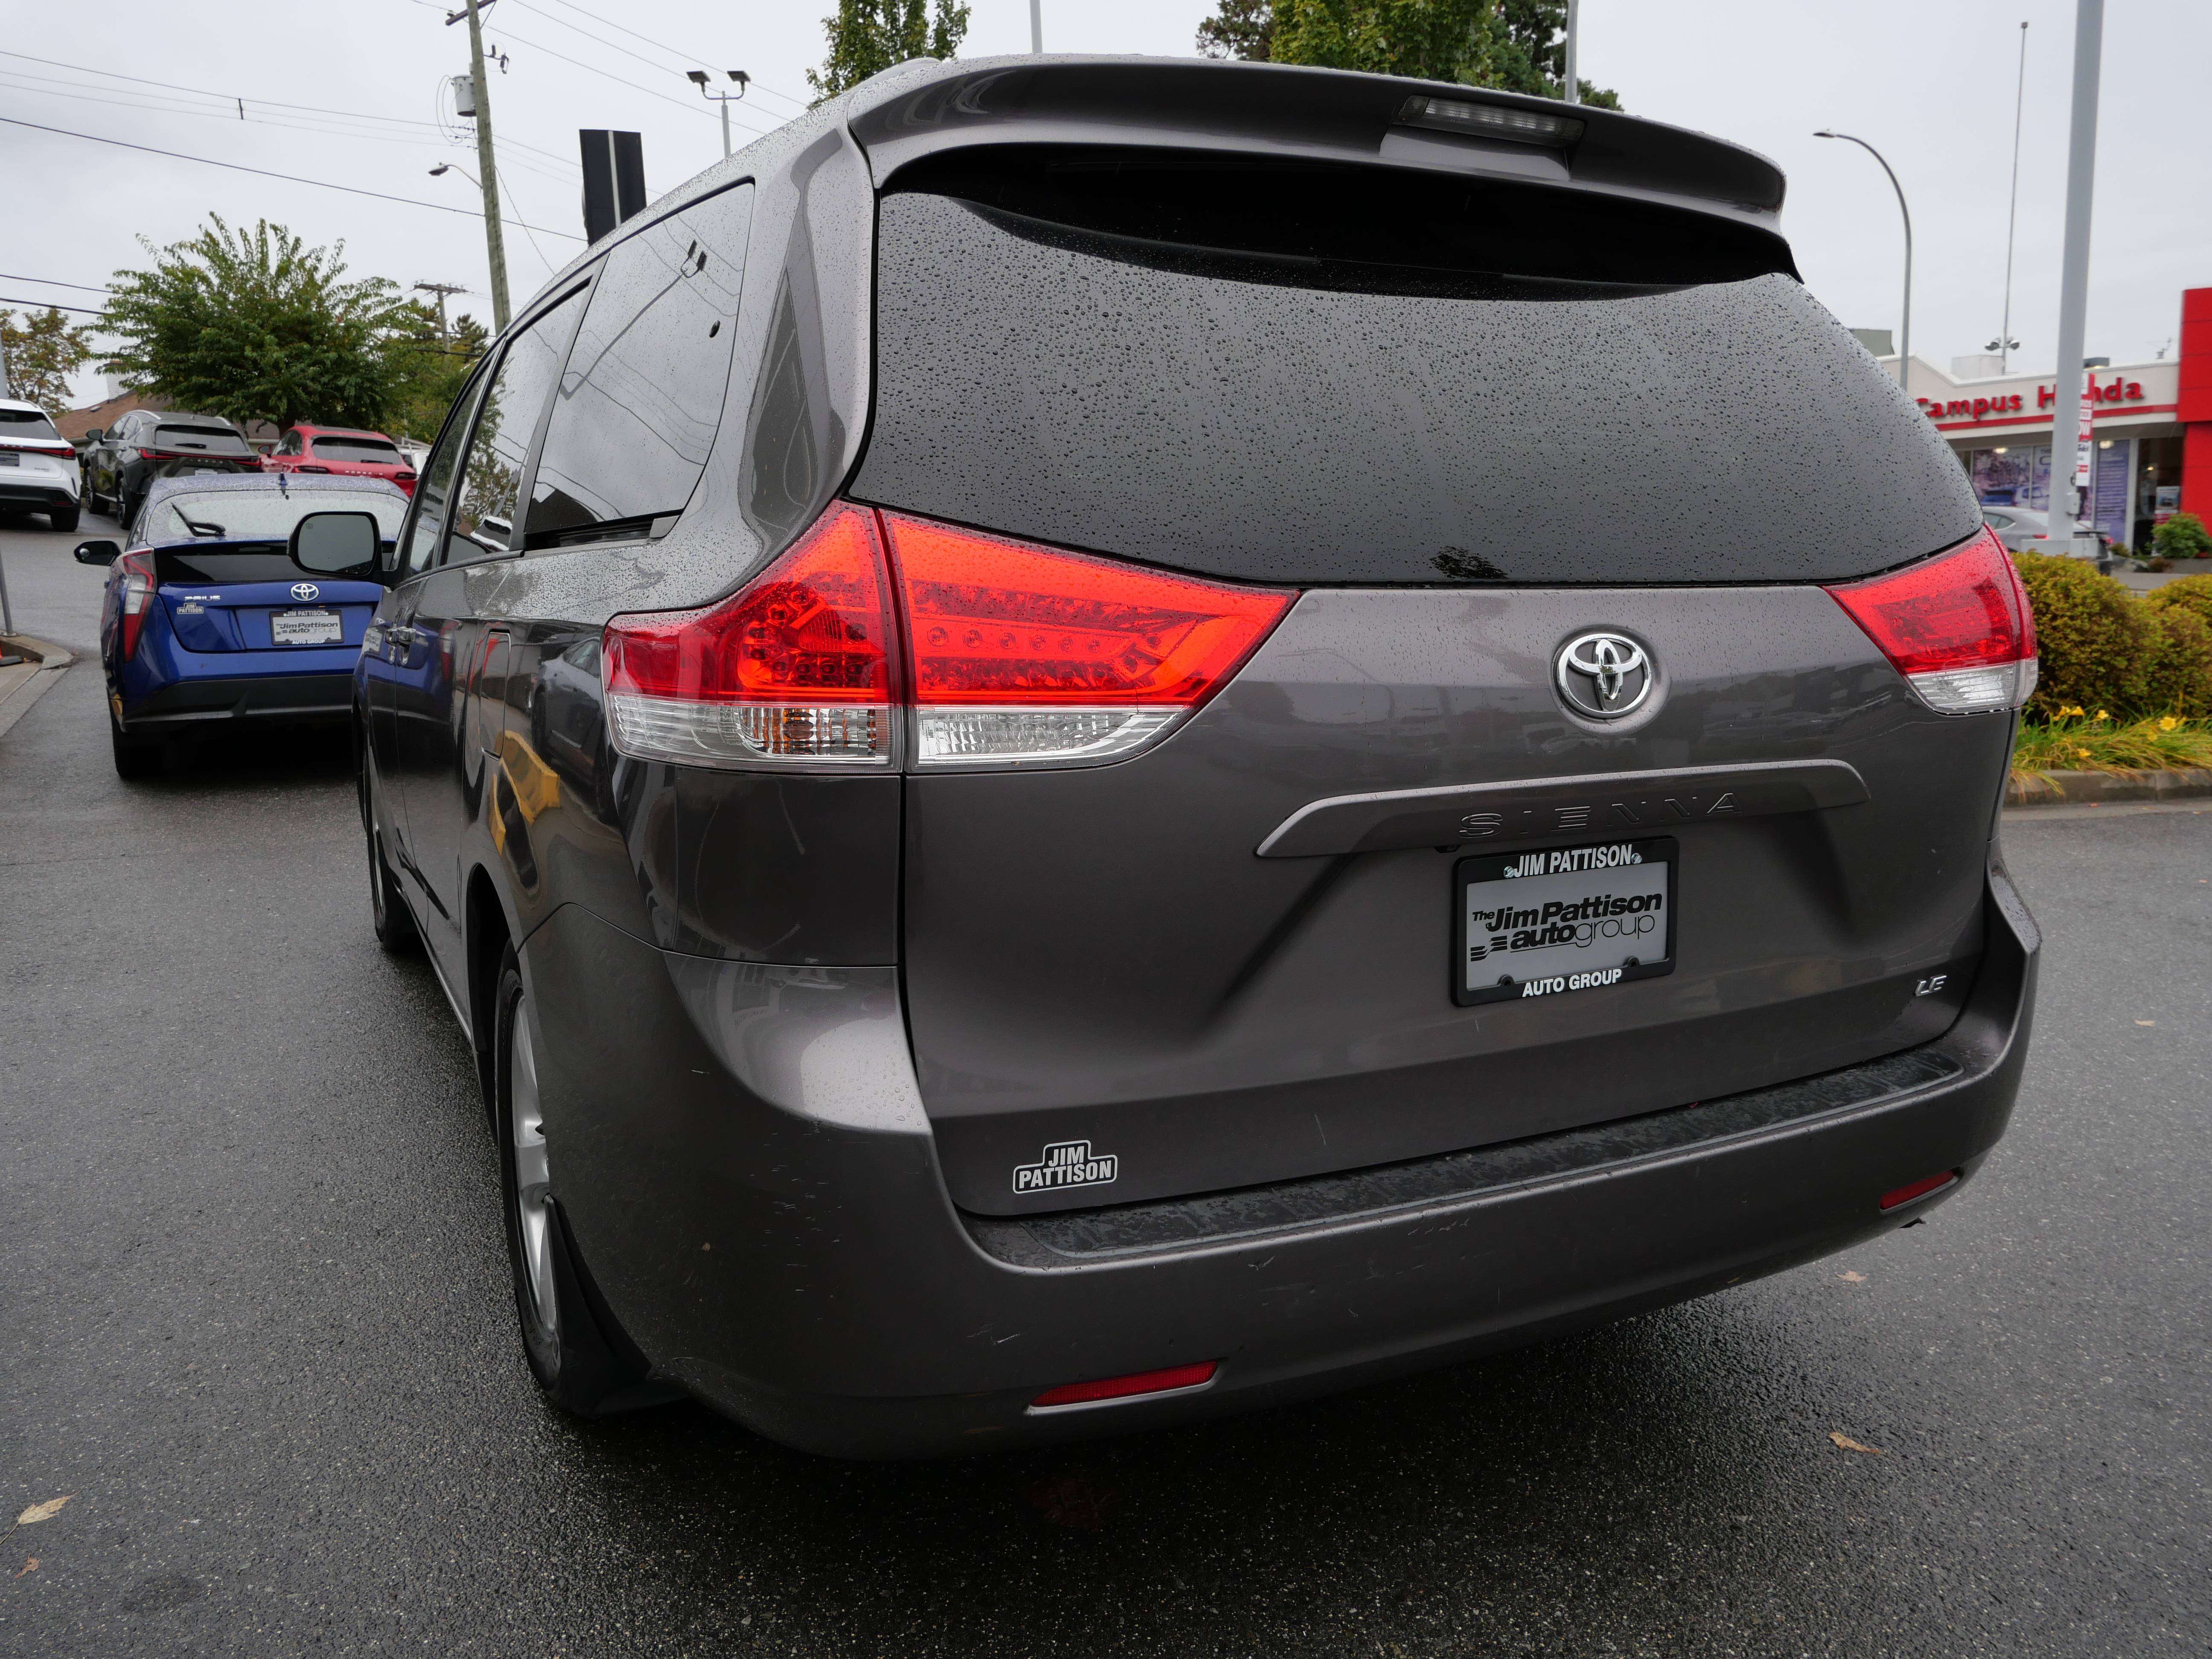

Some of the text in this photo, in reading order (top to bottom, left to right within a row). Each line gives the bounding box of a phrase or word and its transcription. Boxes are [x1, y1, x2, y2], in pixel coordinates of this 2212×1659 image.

[1915, 394, 2022, 420] Campus
[1459, 793, 1742, 838] SIENNA
[1514, 844, 1632, 877] JIM PATTISON
[1473, 894, 1662, 932] The Jim Pattison
[1522, 969, 1622, 998] AUTO GROUP
[1915, 975, 1947, 997] LE
[1048, 1146, 1085, 1167] JIM
[1019, 1160, 1112, 1189] PATTISON
